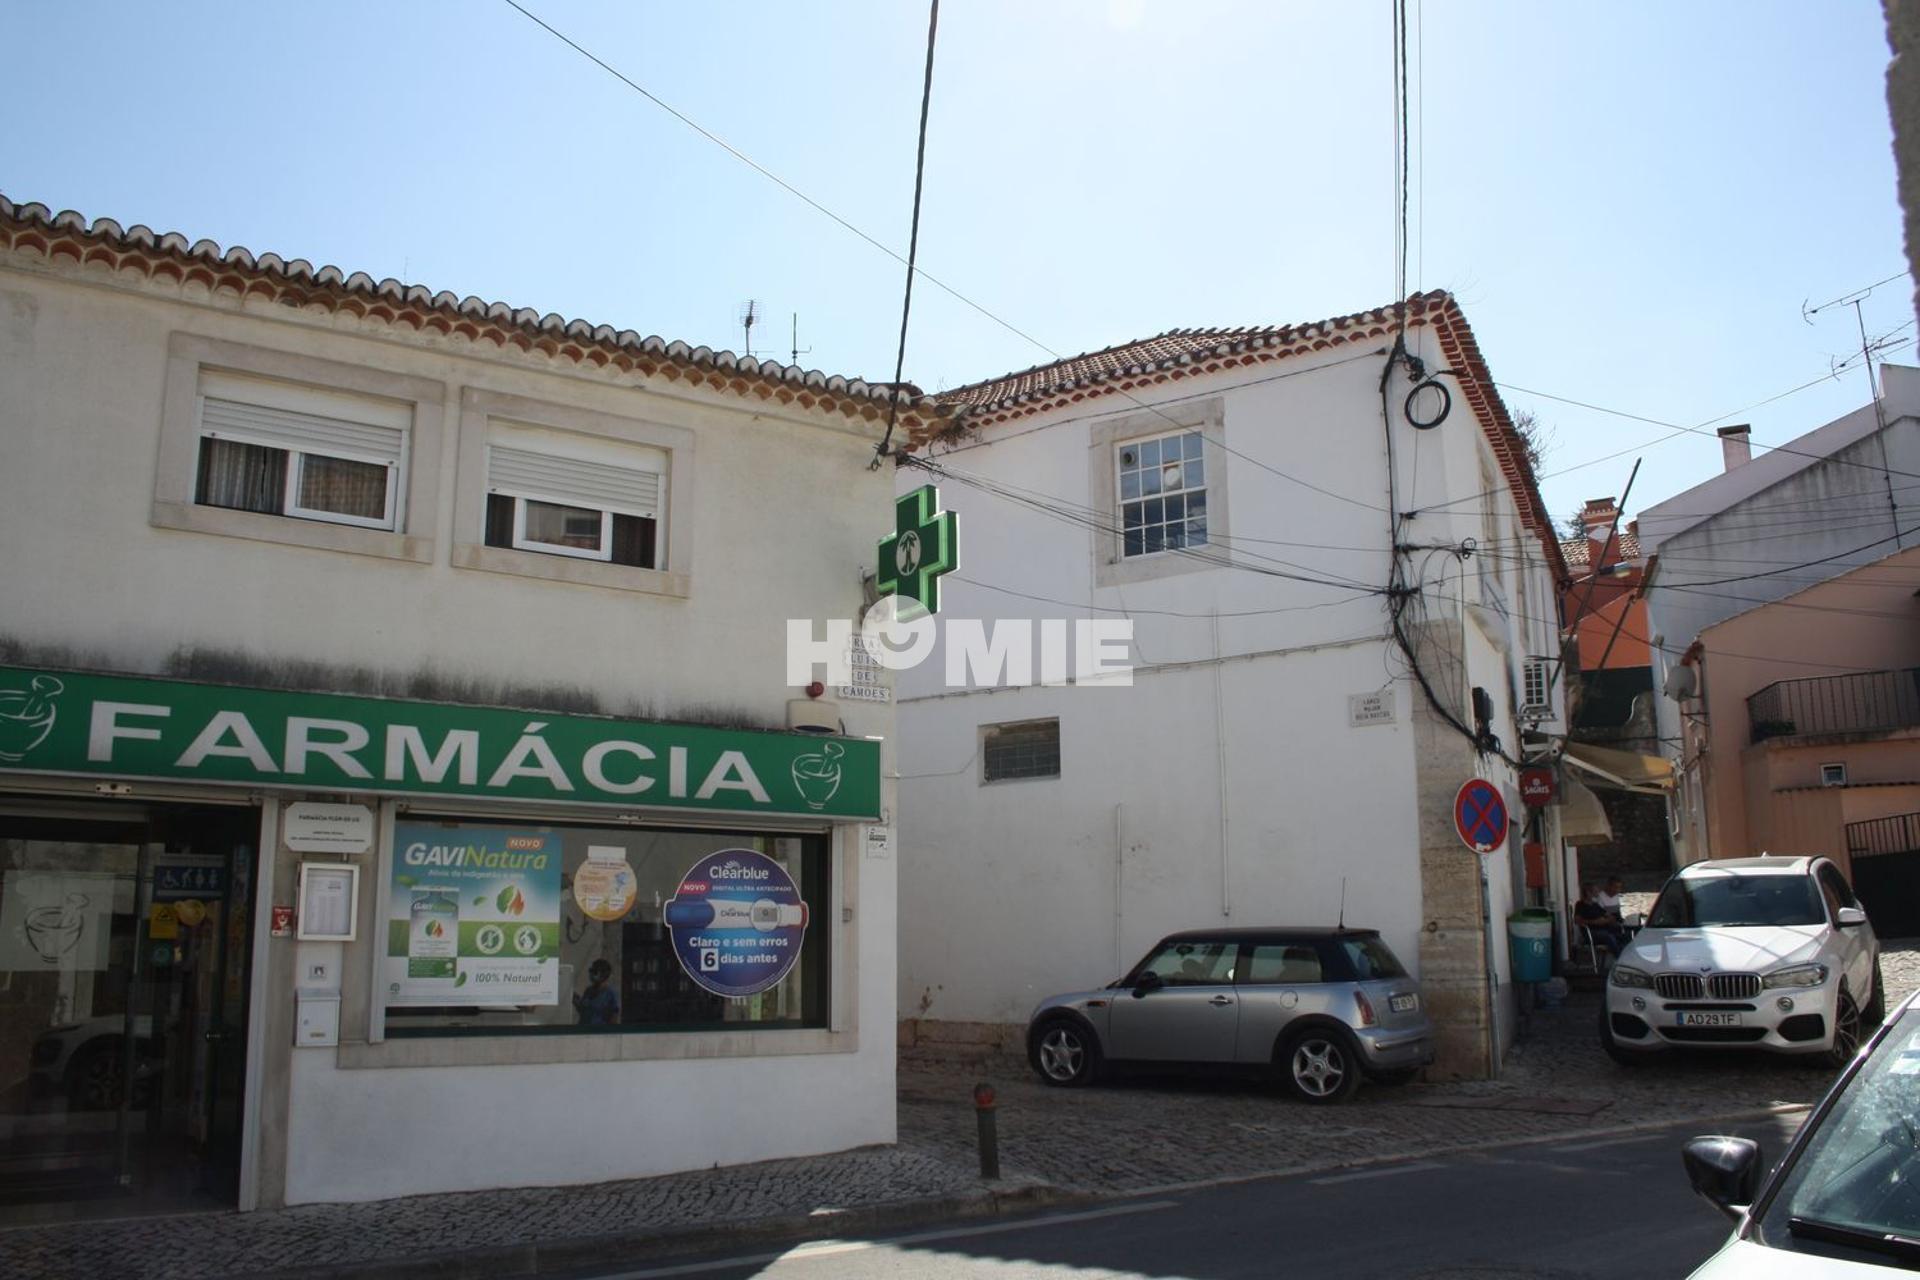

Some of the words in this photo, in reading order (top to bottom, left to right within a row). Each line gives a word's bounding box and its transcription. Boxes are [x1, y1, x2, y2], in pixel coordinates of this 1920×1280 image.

[857, 671, 871, 681] DE
[87, 700, 771, 802] FARMÁCIA
[510, 838, 541, 849] NOVO
[405, 842, 548, 870] GAVINatura
[709, 866, 769, 880] Clearblue
[689, 936, 720, 947] Claro
[723, 939, 731, 947] e
[733, 938, 756, 947] sem
[759, 938, 788, 947] erros
[704, 952, 716, 968] 6
[721, 953, 744, 963] dias
[747, 954, 778, 963] antes
[475, 973, 500, 983] 100%
[503, 973, 542, 984] Natural
